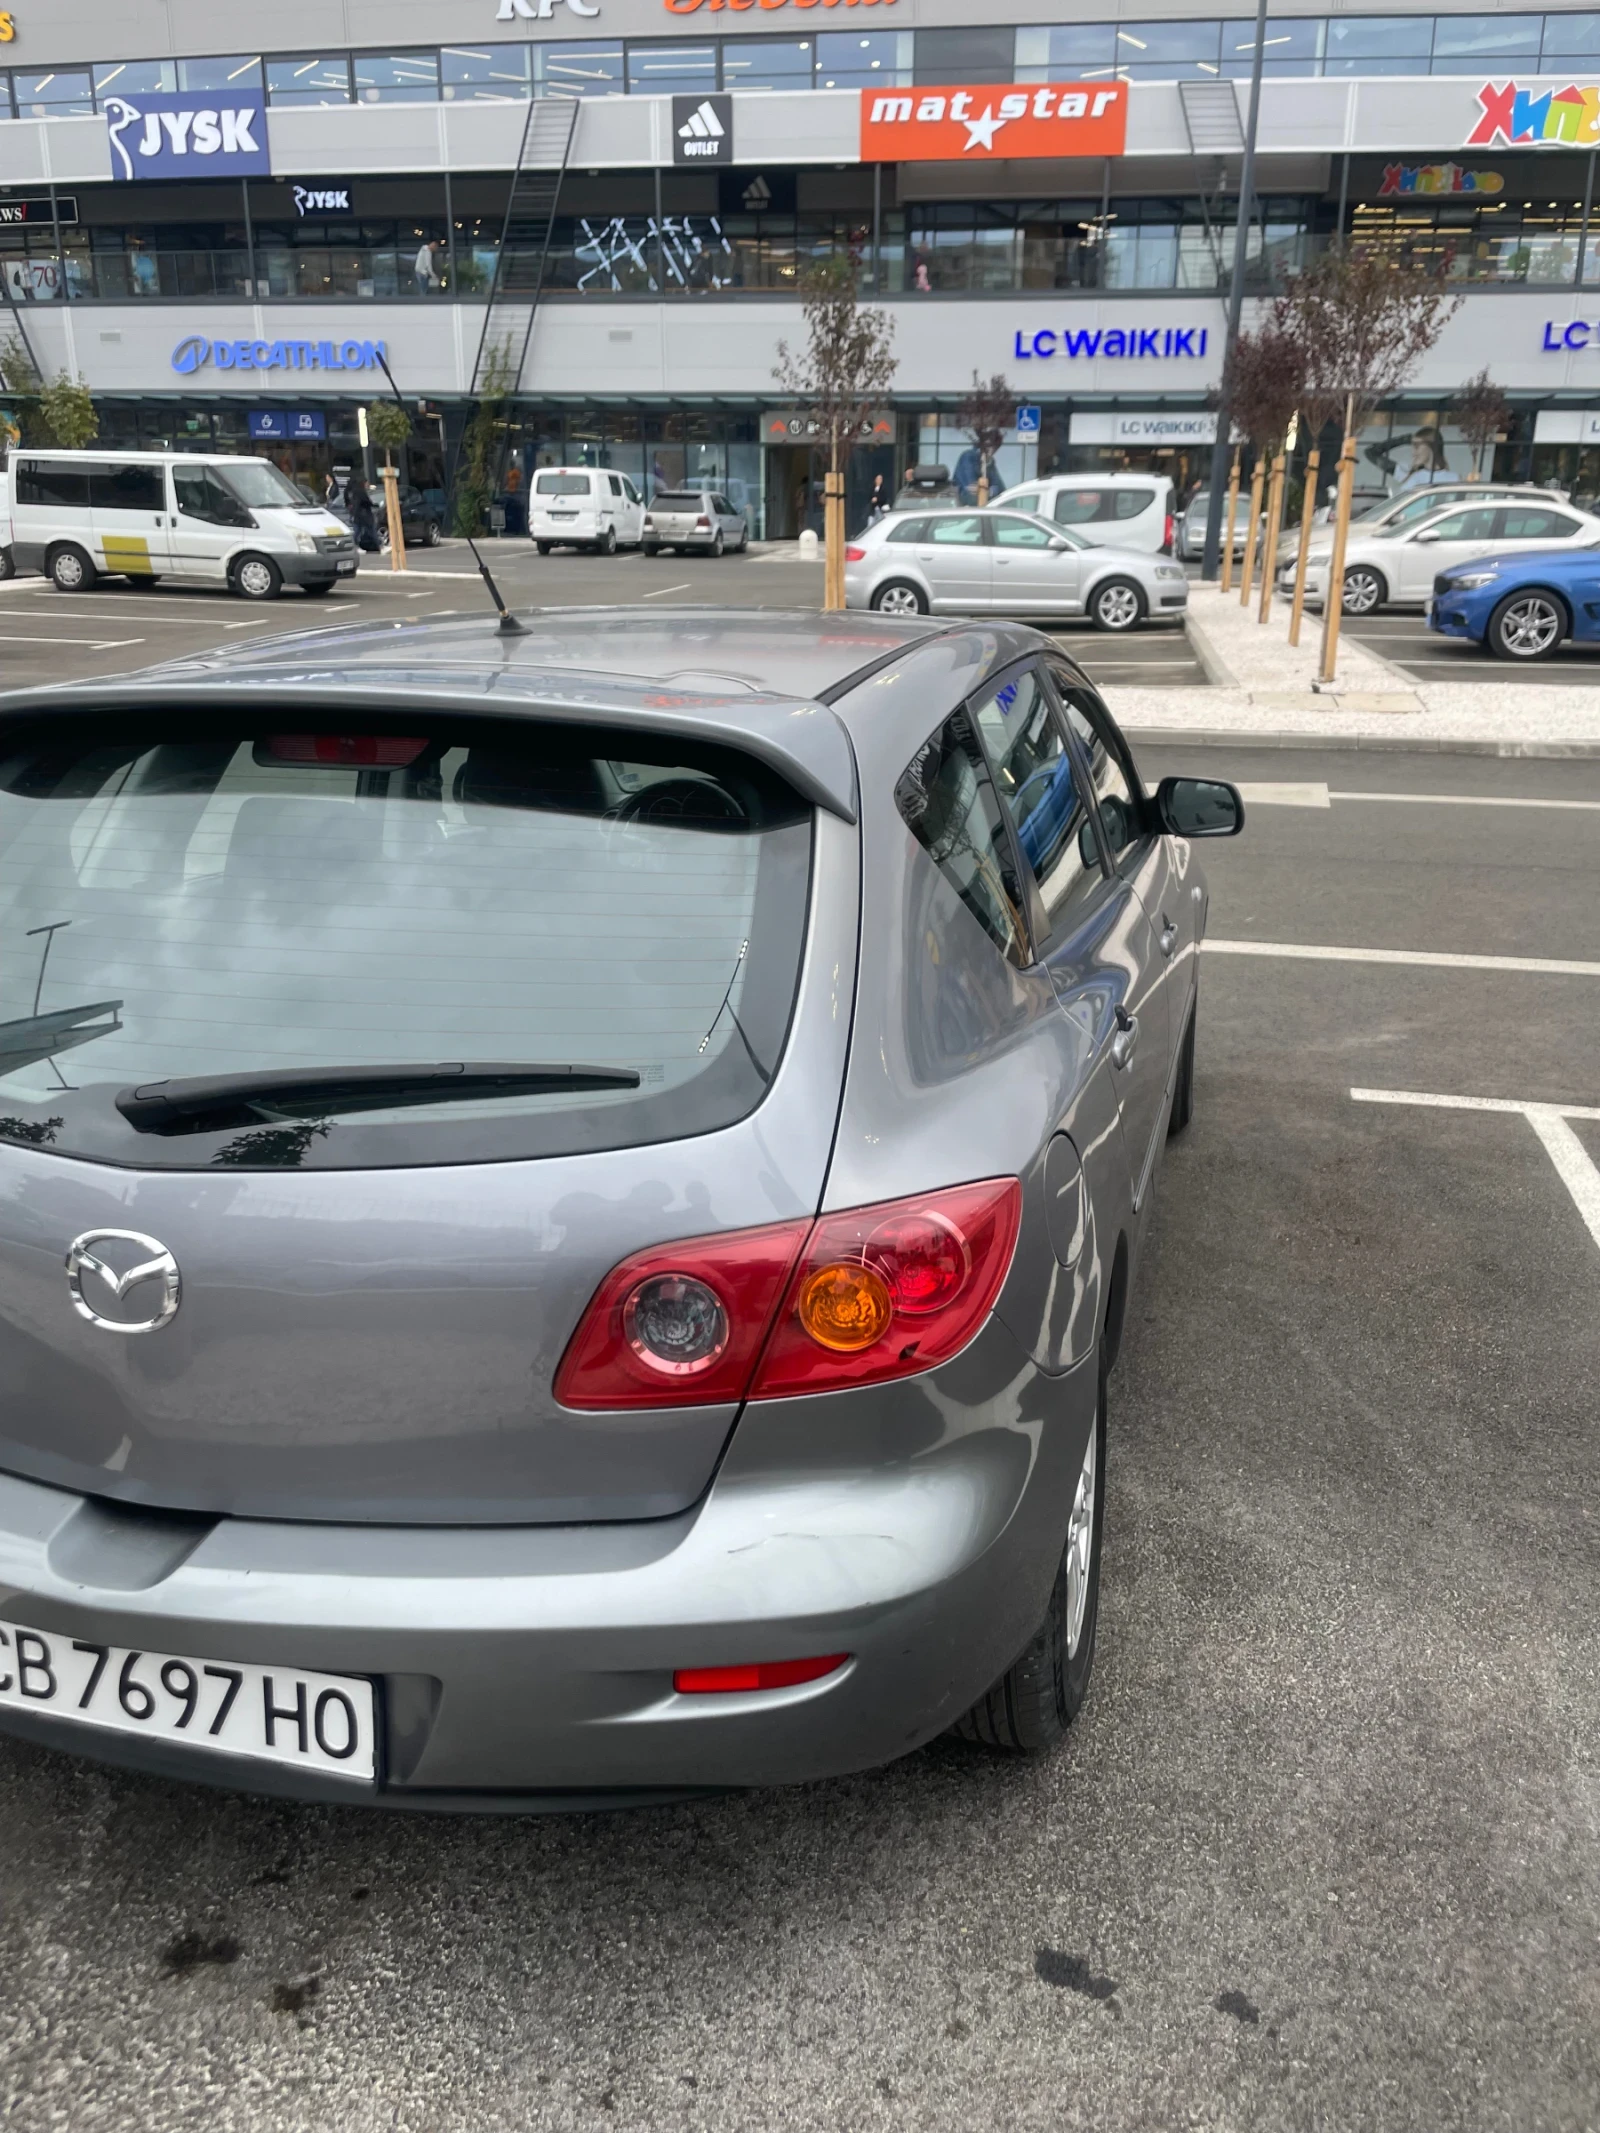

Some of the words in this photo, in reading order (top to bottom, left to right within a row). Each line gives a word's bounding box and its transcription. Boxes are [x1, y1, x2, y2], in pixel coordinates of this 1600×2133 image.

[870, 92, 973, 122] mat
[998, 89, 1118, 119] star
[139, 109, 259, 156] JYSK
[684, 141, 719, 156] OUTLET
[305, 190, 349, 209] JYSK
[1015, 329, 1057, 358] LC
[1542, 321, 1591, 351] LC
[213, 340, 386, 369] DECATHLON
[1121, 421, 1140, 434] LC
[72, 1640, 244, 1735] 7697
[263, 1675, 359, 1759] HO
